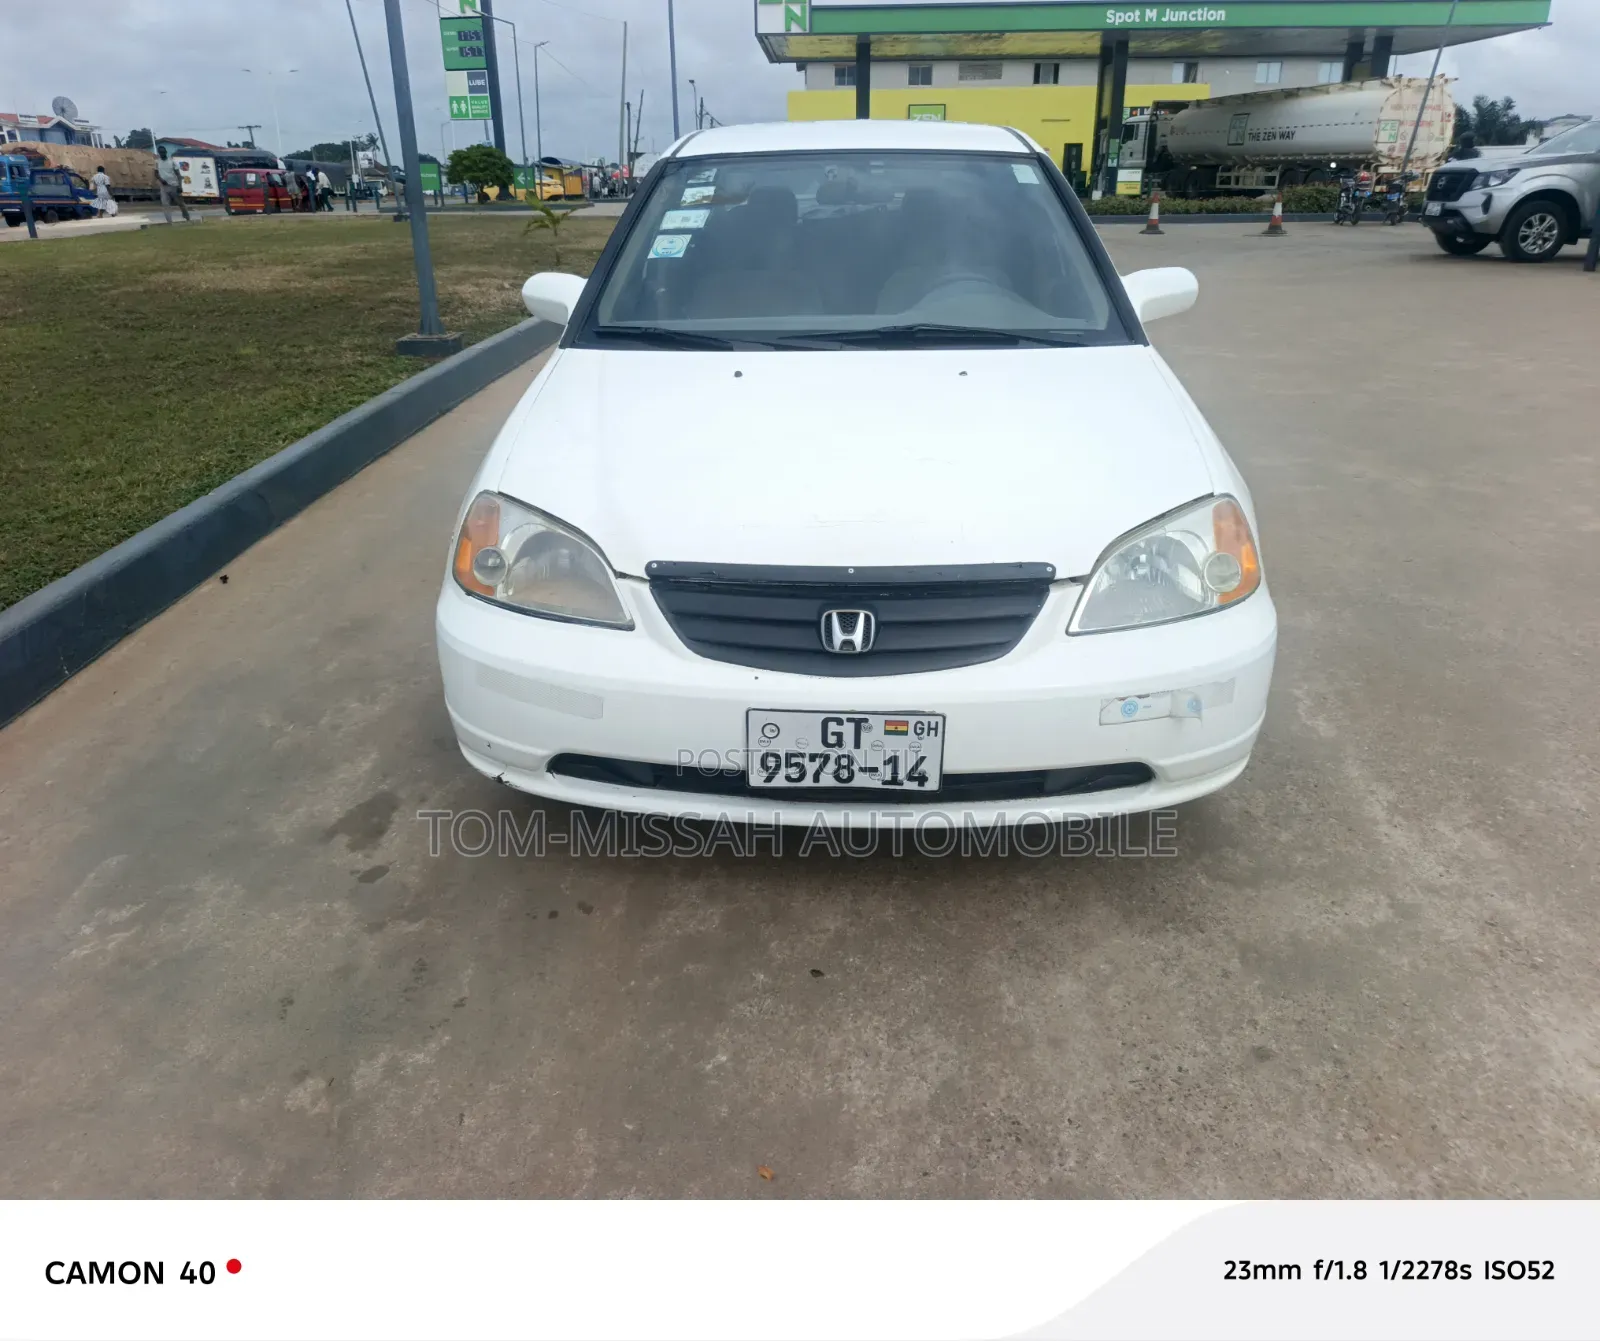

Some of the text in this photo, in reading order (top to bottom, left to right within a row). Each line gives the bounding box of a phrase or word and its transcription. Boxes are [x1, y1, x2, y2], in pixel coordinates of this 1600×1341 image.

[1106, 7, 1226, 26] Spot M Junction
[1248, 130, 1296, 142] THE ZEN WAY
[821, 717, 869, 750] GT
[913, 720, 939, 738] GH
[760, 752, 928, 787] 9578-14
